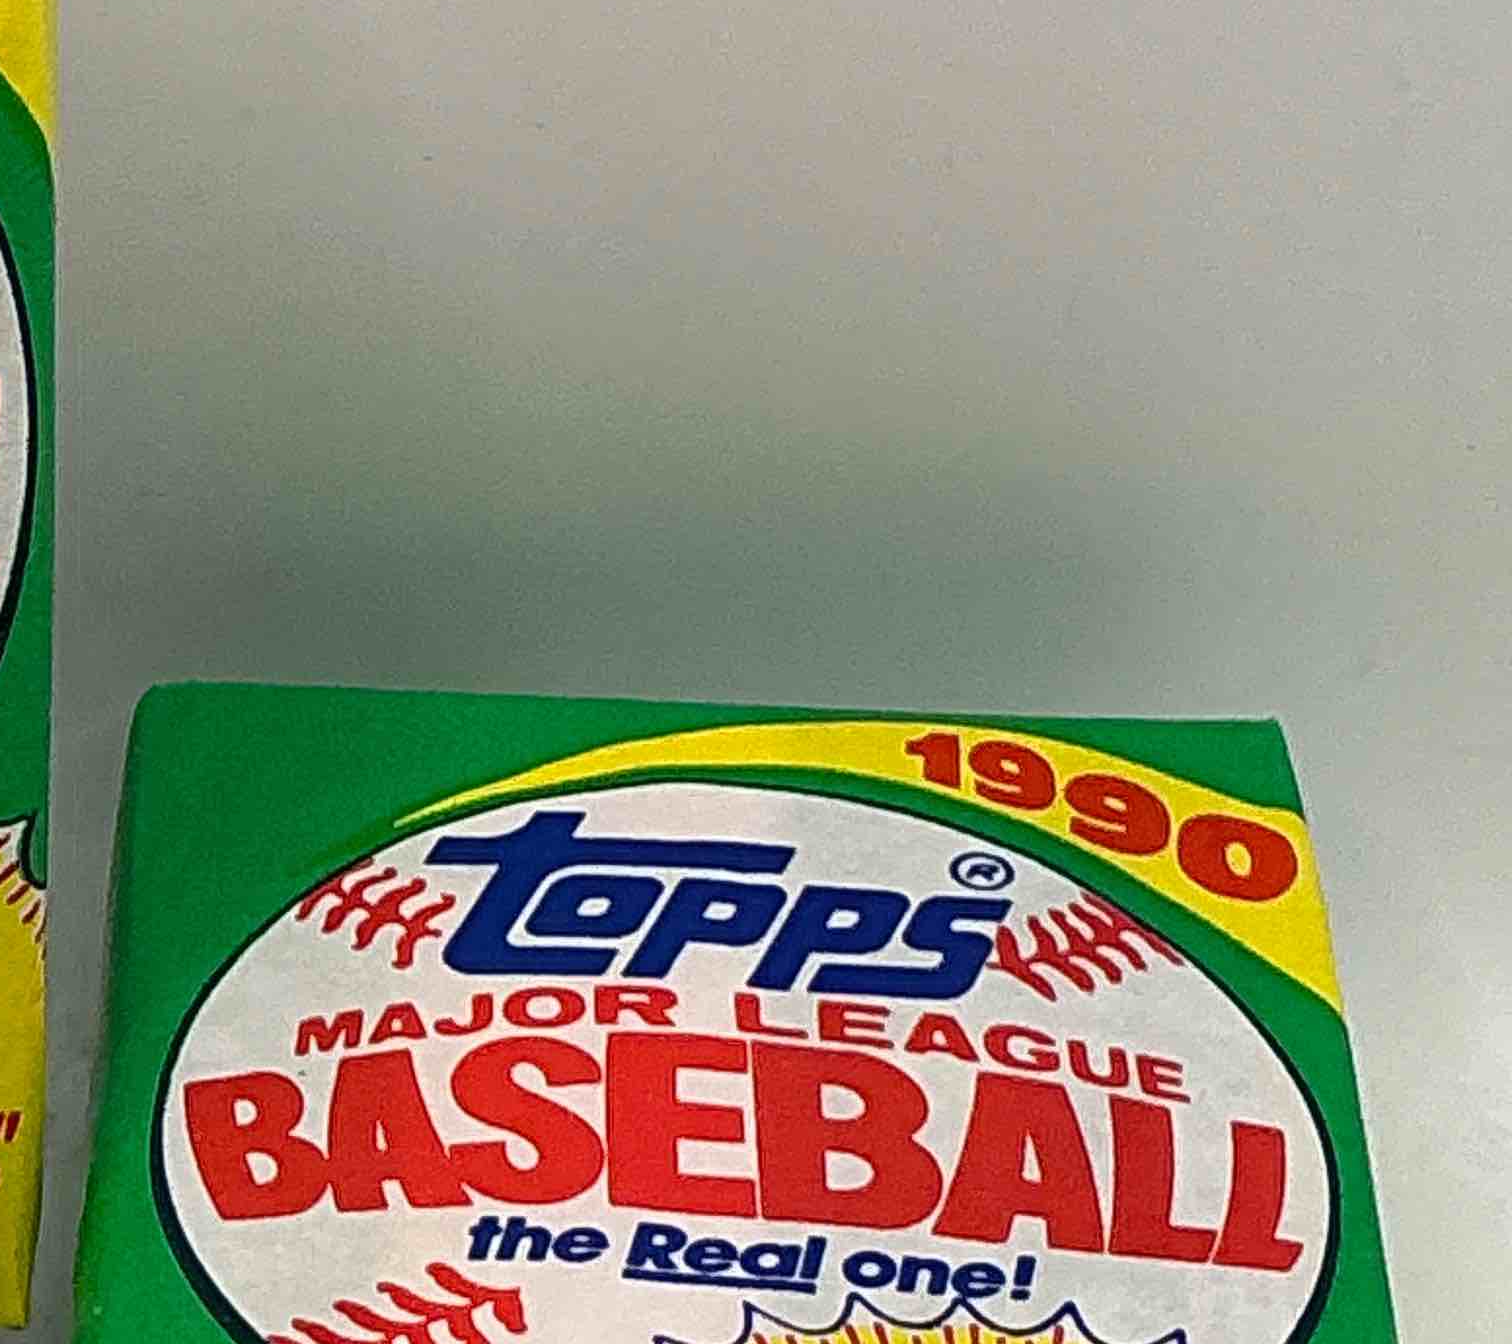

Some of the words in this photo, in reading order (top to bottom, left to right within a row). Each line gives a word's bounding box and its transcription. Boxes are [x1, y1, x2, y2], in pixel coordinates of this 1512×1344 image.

[906, 733, 1298, 903] 1990
[295, 985, 675, 1056] MAJOR
[735, 992, 1189, 1102] LEAGUE
[183, 1032, 1304, 1272] BASEBALL
[467, 1217, 610, 1262] the
[622, 1226, 825, 1294] Real
[842, 1246, 1037, 1300] one!
